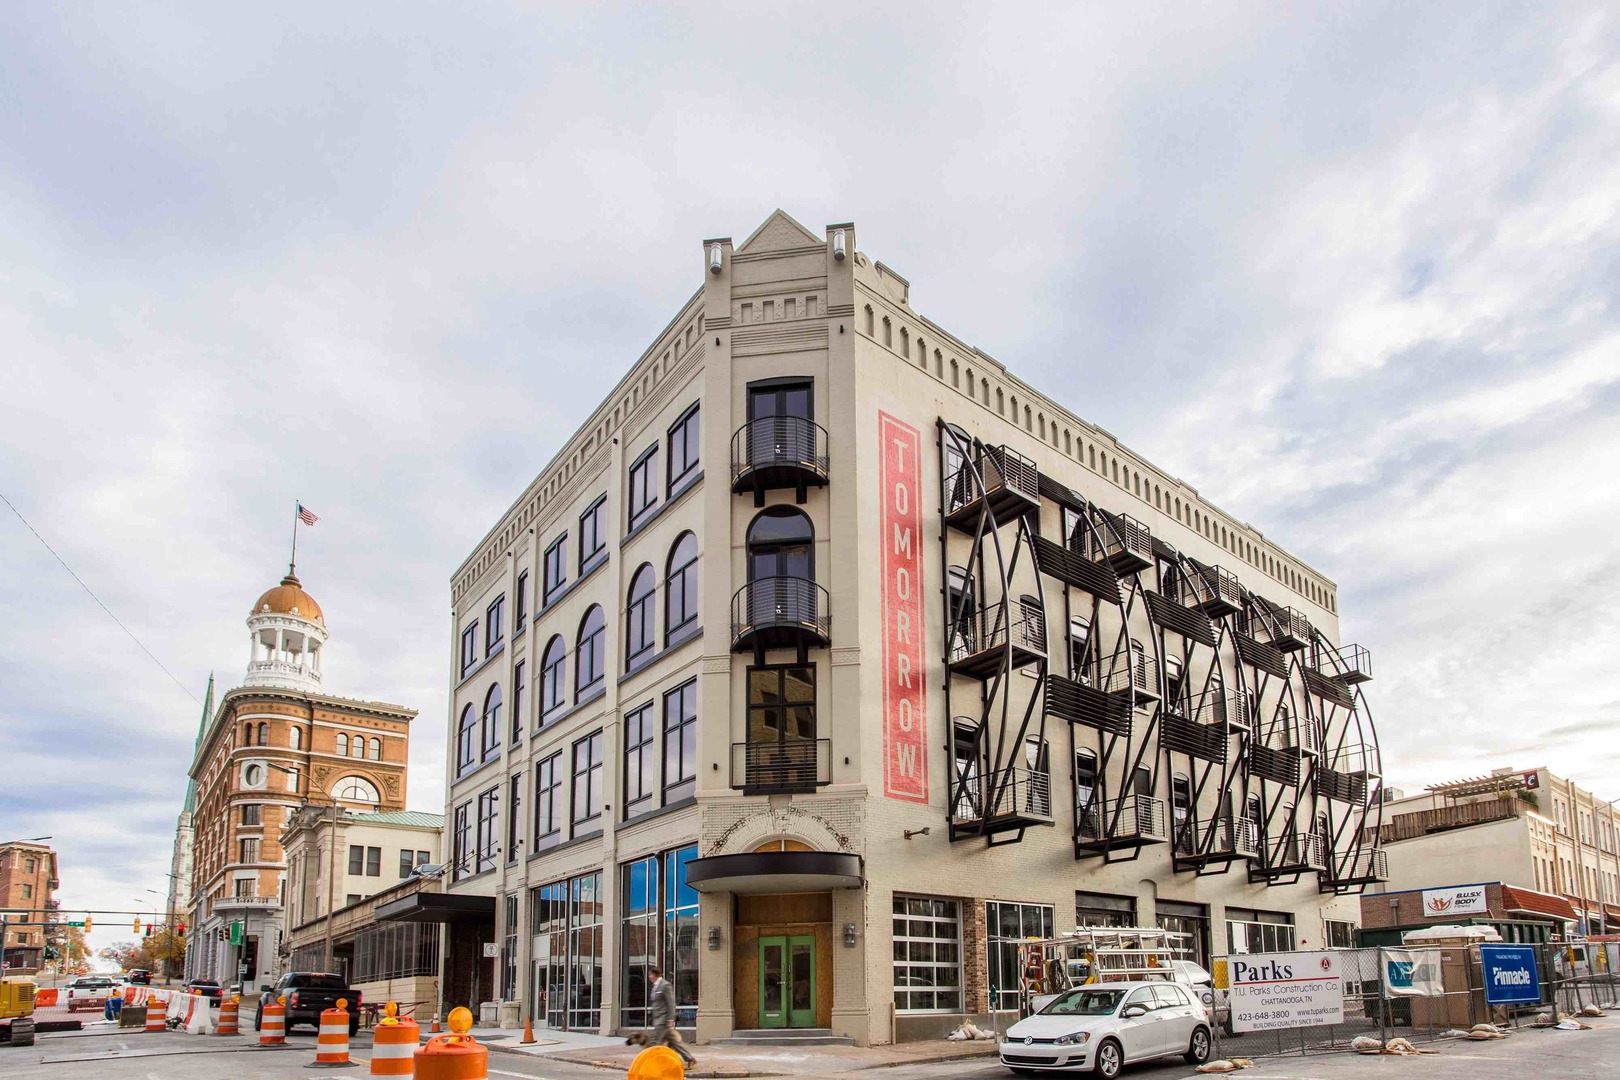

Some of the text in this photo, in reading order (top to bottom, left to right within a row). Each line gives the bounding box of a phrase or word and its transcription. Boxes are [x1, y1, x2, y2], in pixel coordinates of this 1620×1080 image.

[893, 438, 916, 778] TOMORROW
[1232, 960, 1293, 982] Parks
[1492, 966, 1531, 985] Pinnacle
[1234, 982, 1338, 996] T.U. Parks Construction Co.
[1304, 995, 1313, 1003] TN
[1237, 1006, 1340, 1021] 423-648-3800 www.tuparks.com
[1253, 1021, 1277, 1029] BUILDING
